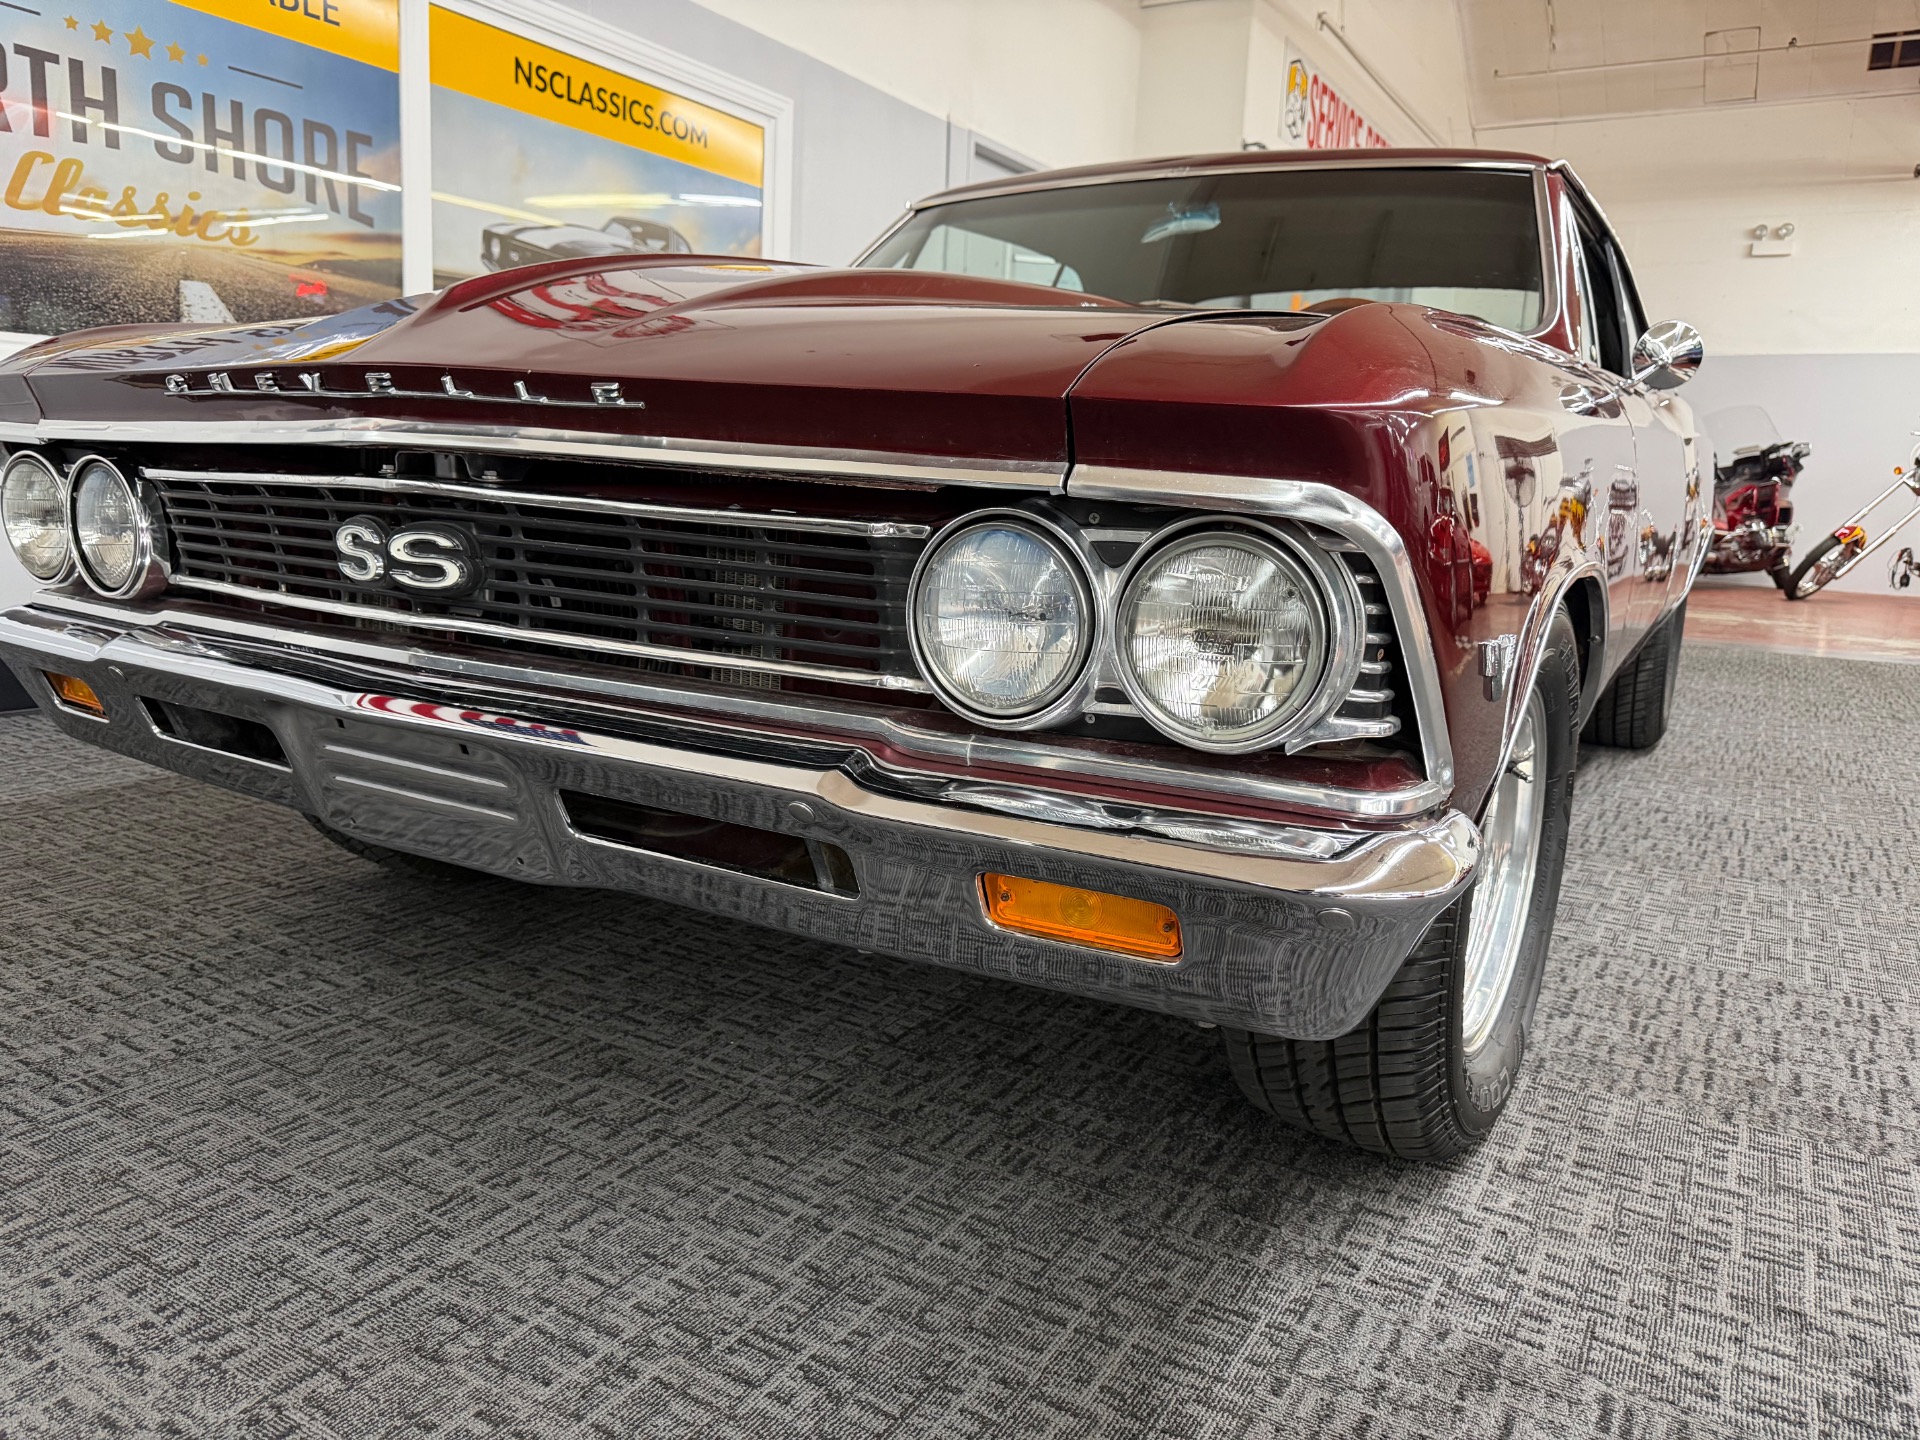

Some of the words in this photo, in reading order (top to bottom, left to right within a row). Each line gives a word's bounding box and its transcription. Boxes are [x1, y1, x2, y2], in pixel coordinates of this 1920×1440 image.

[514, 56, 709, 149] NSCLASSICS.COM
[1307, 73, 1363, 149] SERVICE
[151, 81, 375, 229] SHORE
[3, 150, 260, 247] Classics
[165, 371, 627, 406] CHEVELLE
[335, 523, 469, 591] SS
